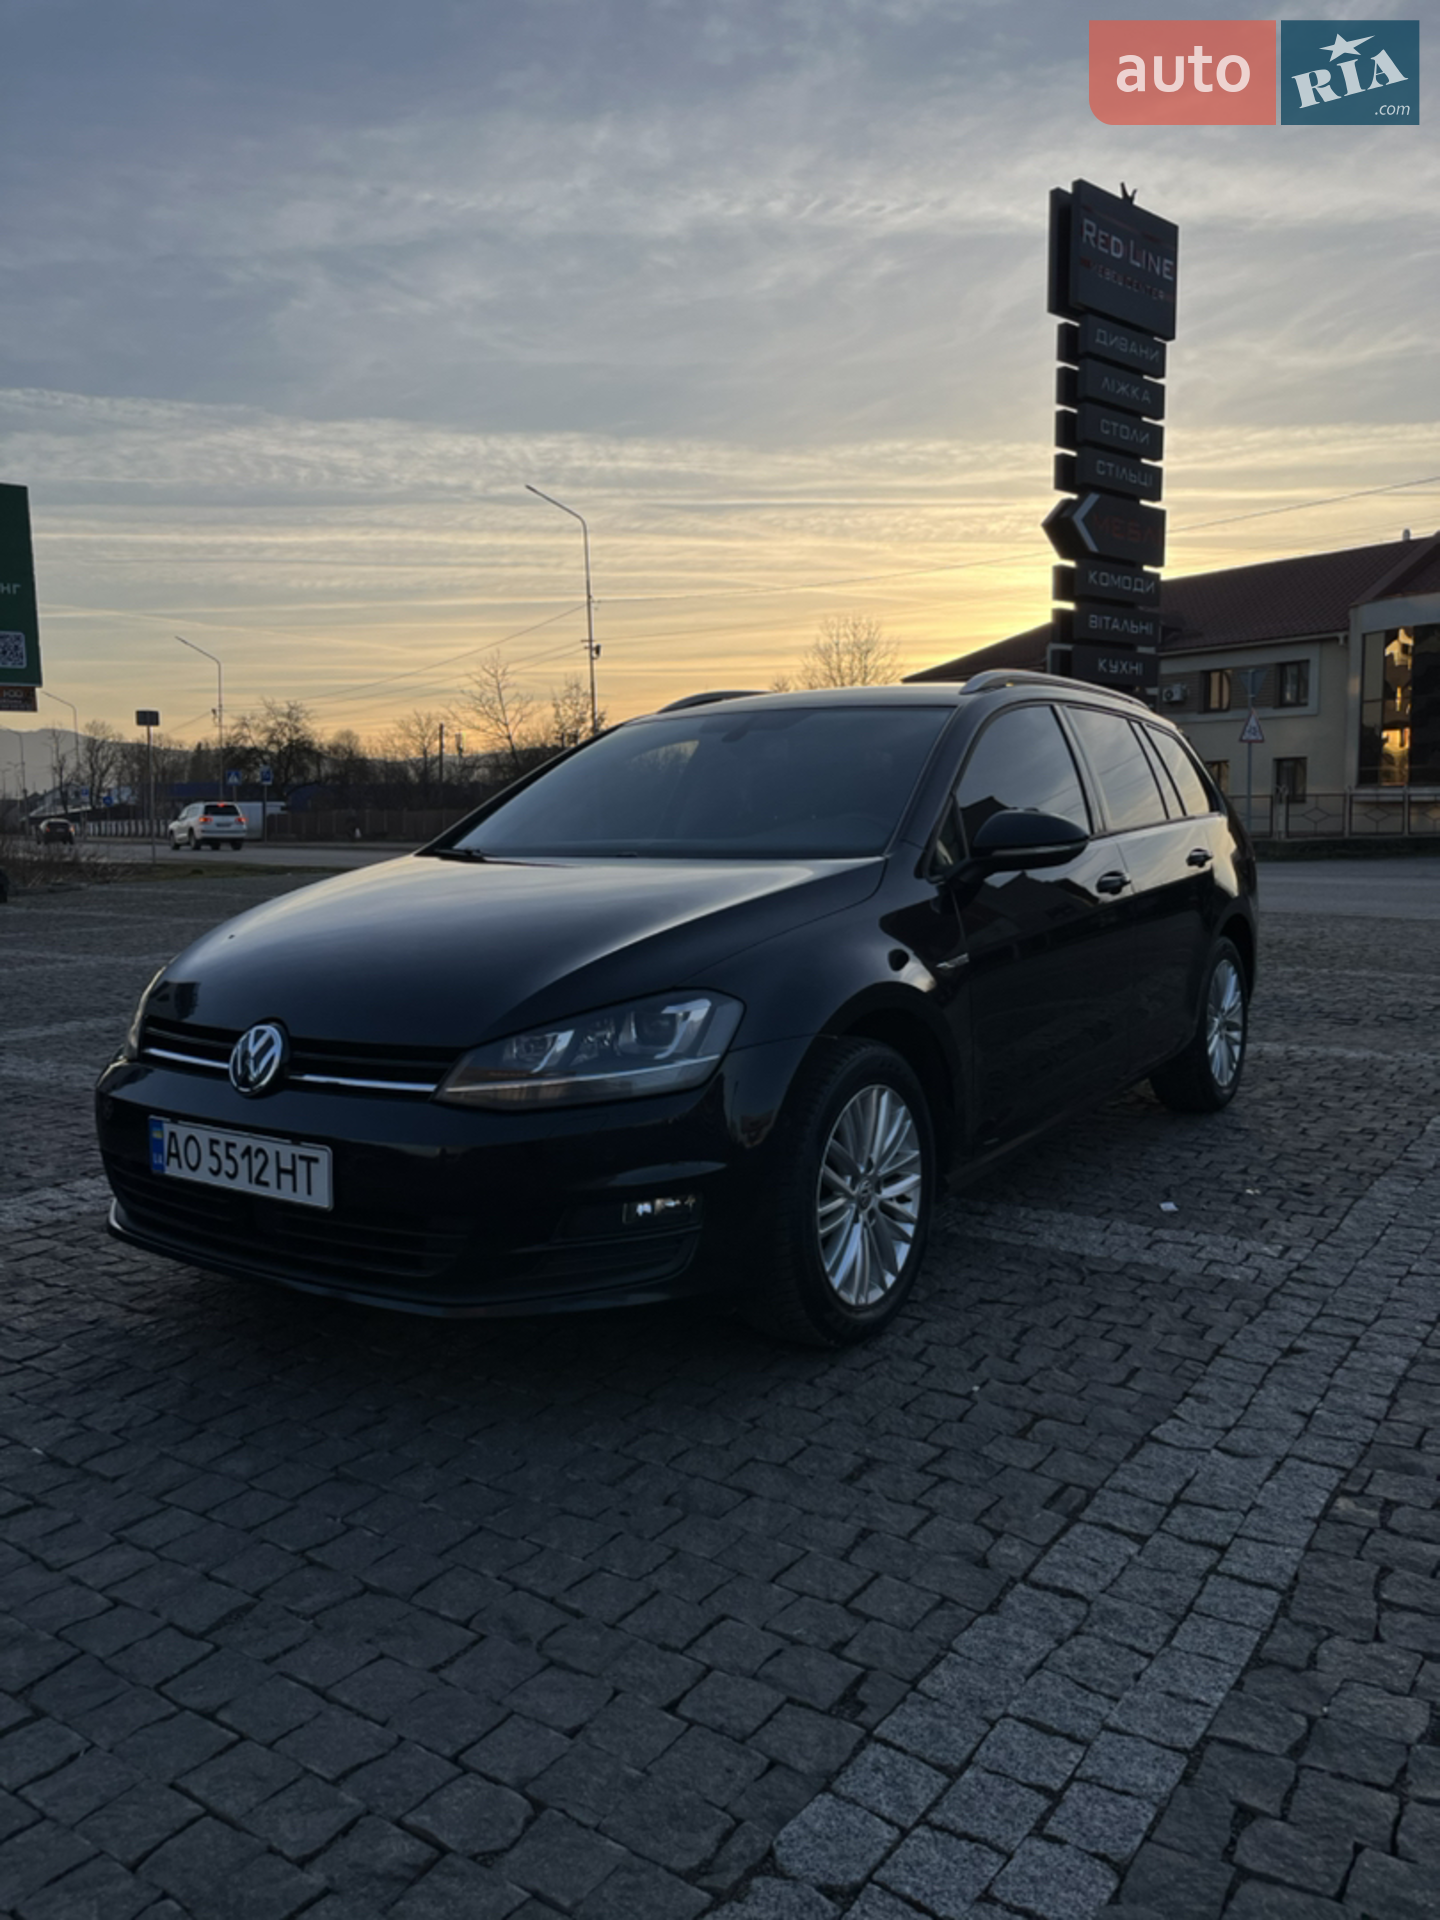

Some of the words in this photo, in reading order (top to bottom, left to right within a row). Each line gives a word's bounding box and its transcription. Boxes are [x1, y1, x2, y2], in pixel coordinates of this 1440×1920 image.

[1095, 328, 1160, 363] ДИВАНИ
[1101, 377, 1152, 404] ЛІЖКА
[1101, 419, 1150, 445] СТОЛИ
[1096, 460, 1153, 487] СТІЛЬЦІ
[1088, 570, 1155, 594] КОМОДИ
[1088, 614, 1153, 635] ВІТАЛЬНІ
[1098, 658, 1143, 676] КУХНІ
[166, 1131, 201, 1172] AO
[208, 1138, 270, 1188] 5512
[275, 1150, 319, 1196] HT
